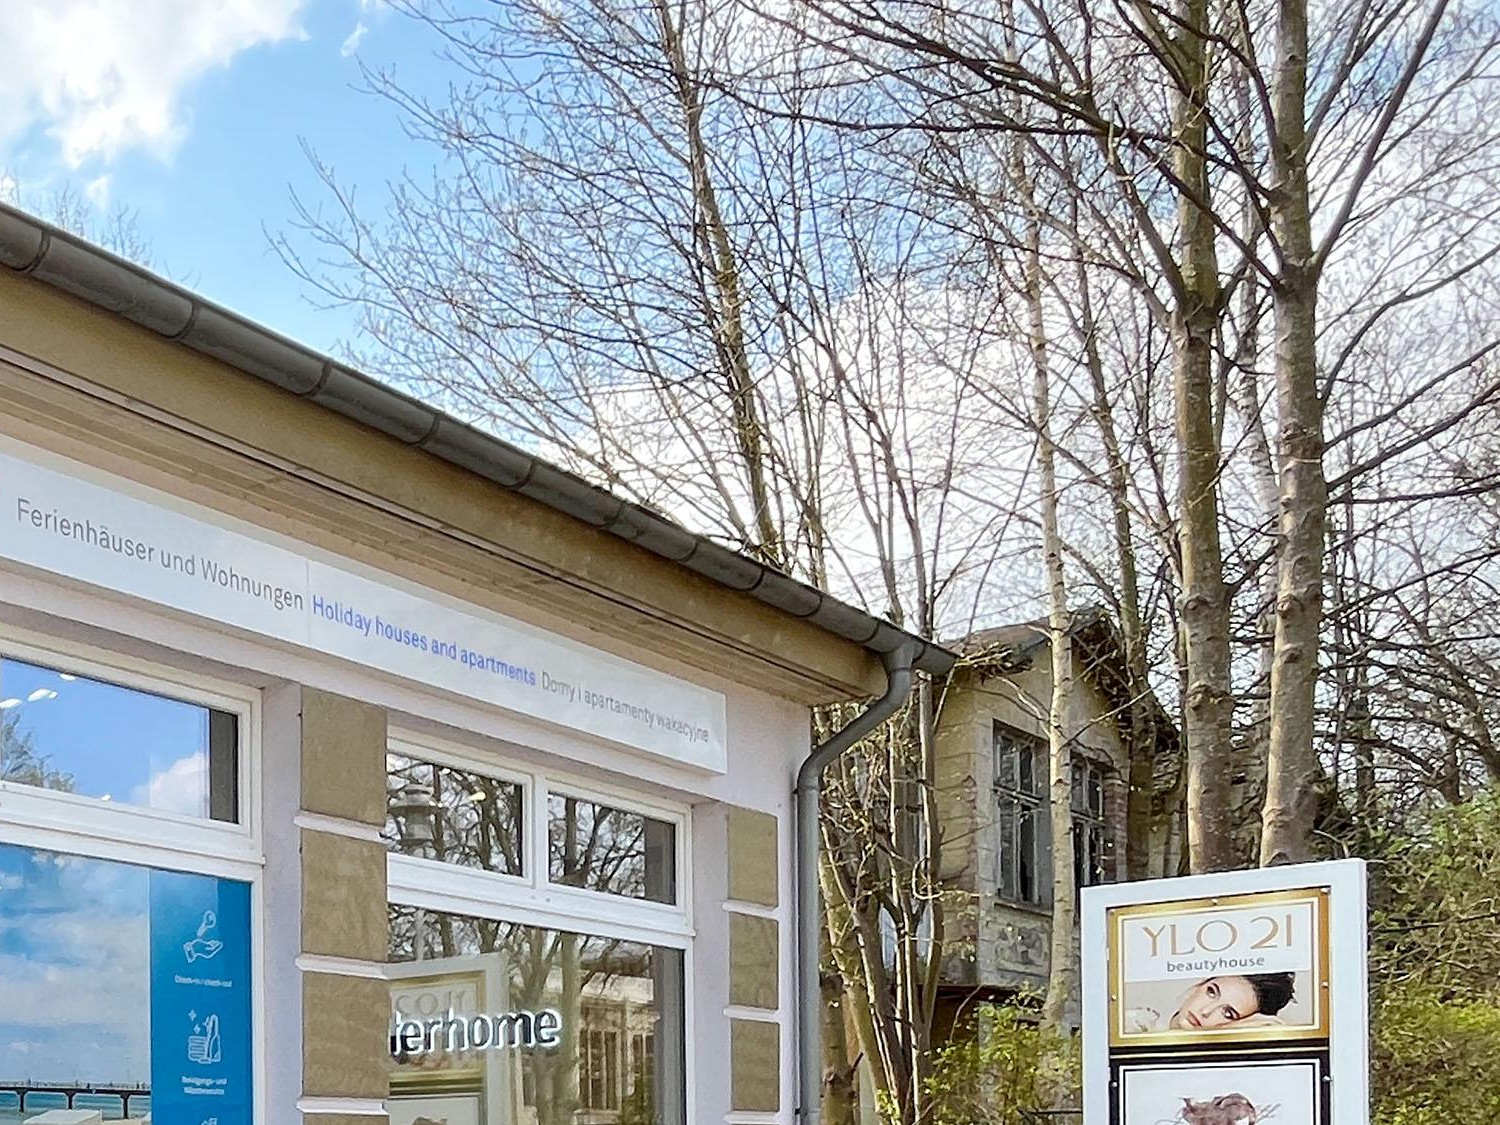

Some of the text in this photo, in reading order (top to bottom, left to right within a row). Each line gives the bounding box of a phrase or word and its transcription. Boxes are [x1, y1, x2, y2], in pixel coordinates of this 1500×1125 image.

[16, 498, 155, 562] Ferienhäuser
[160, 550, 195, 576] und
[200, 558, 304, 611] Wohnungen
[312, 595, 371, 637] Holiday
[375, 615, 428, 651] houses
[431, 640, 457, 661] and
[460, 648, 536, 686] apartments
[541, 671, 576, 702] Domy
[584, 690, 655, 728] apartamenty
[656, 713, 709, 744] wakacyjne
[1142, 914, 1293, 957] YLO 21
[1166, 956, 1266, 973] beautyhouse
